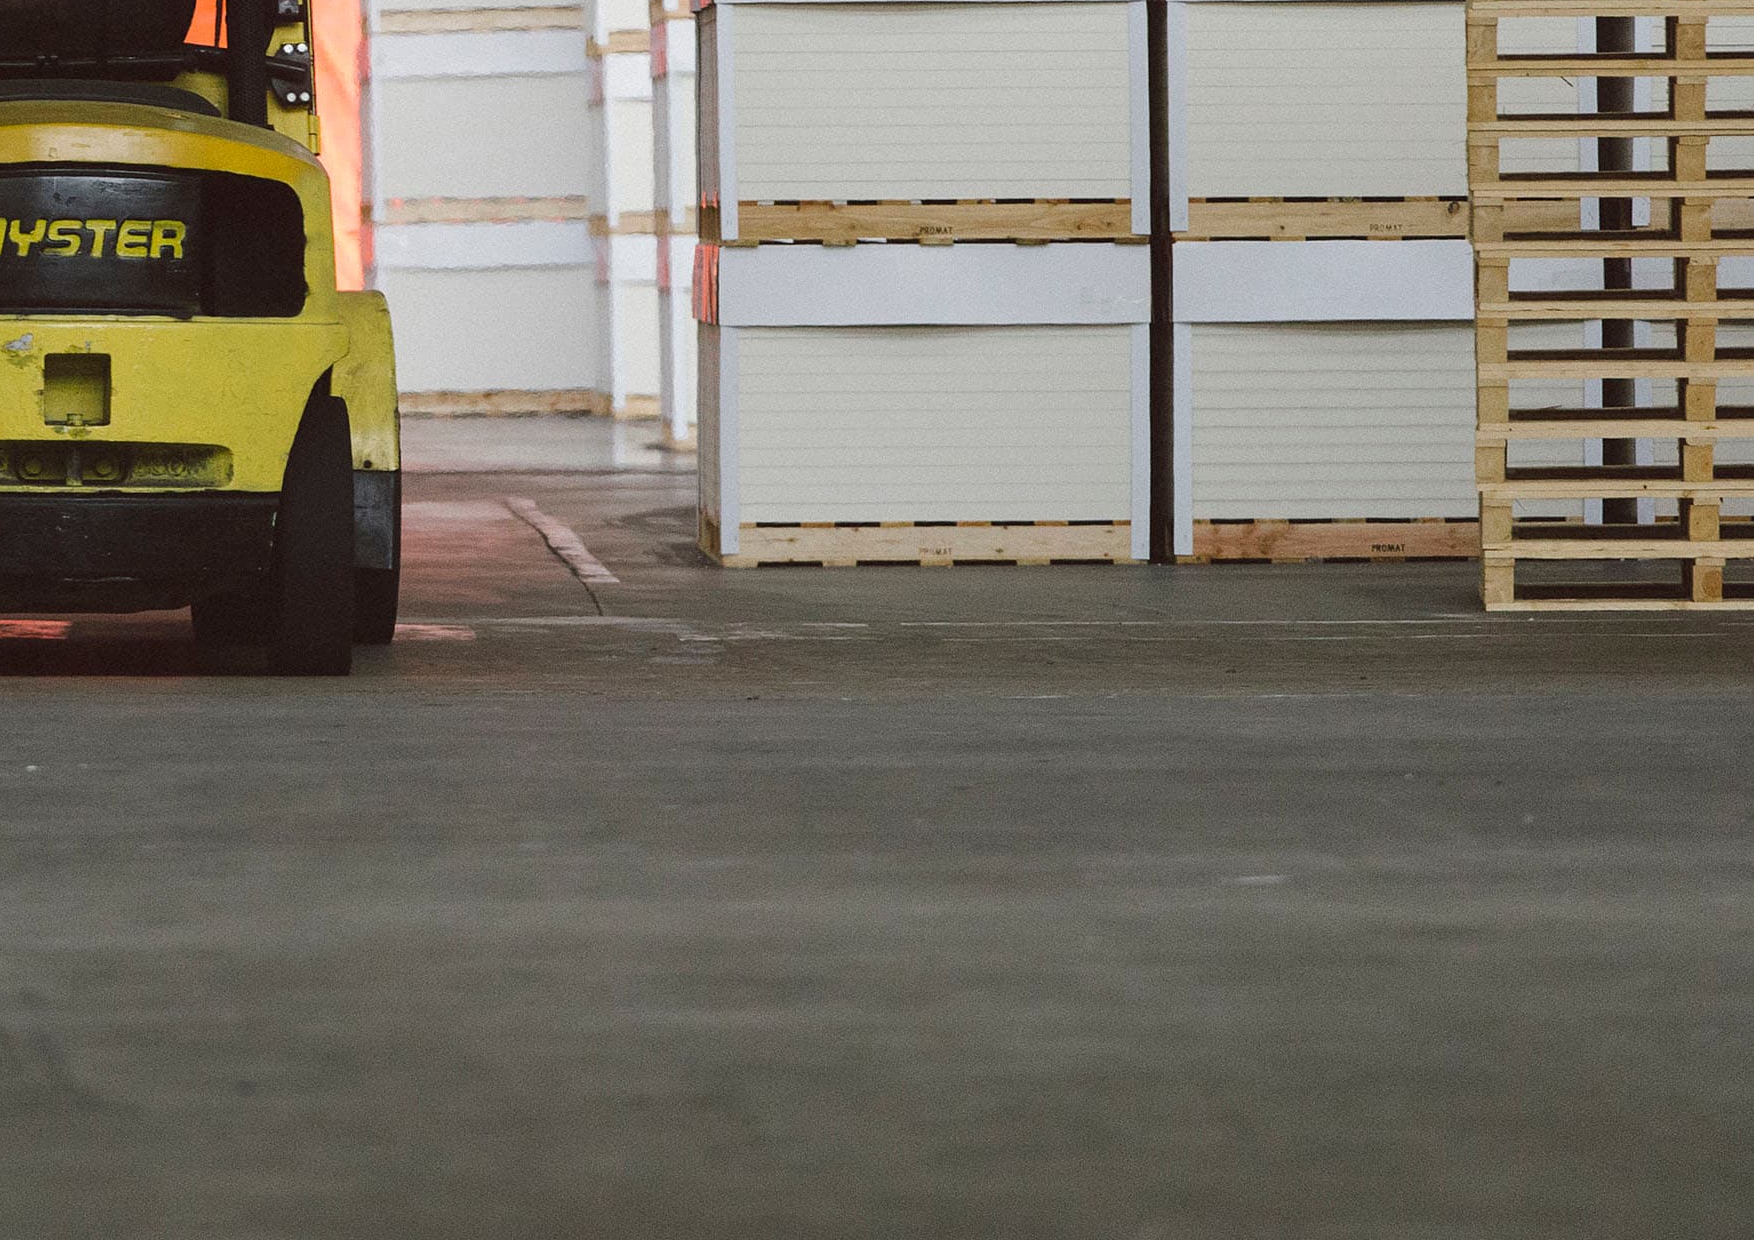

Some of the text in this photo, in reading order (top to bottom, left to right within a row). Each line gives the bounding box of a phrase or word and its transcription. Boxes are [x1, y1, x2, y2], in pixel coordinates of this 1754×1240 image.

[919, 226, 953, 235] PROMAT
[1369, 223, 1402, 232] PROMAT
[1371, 543, 1405, 553] PROMAT
